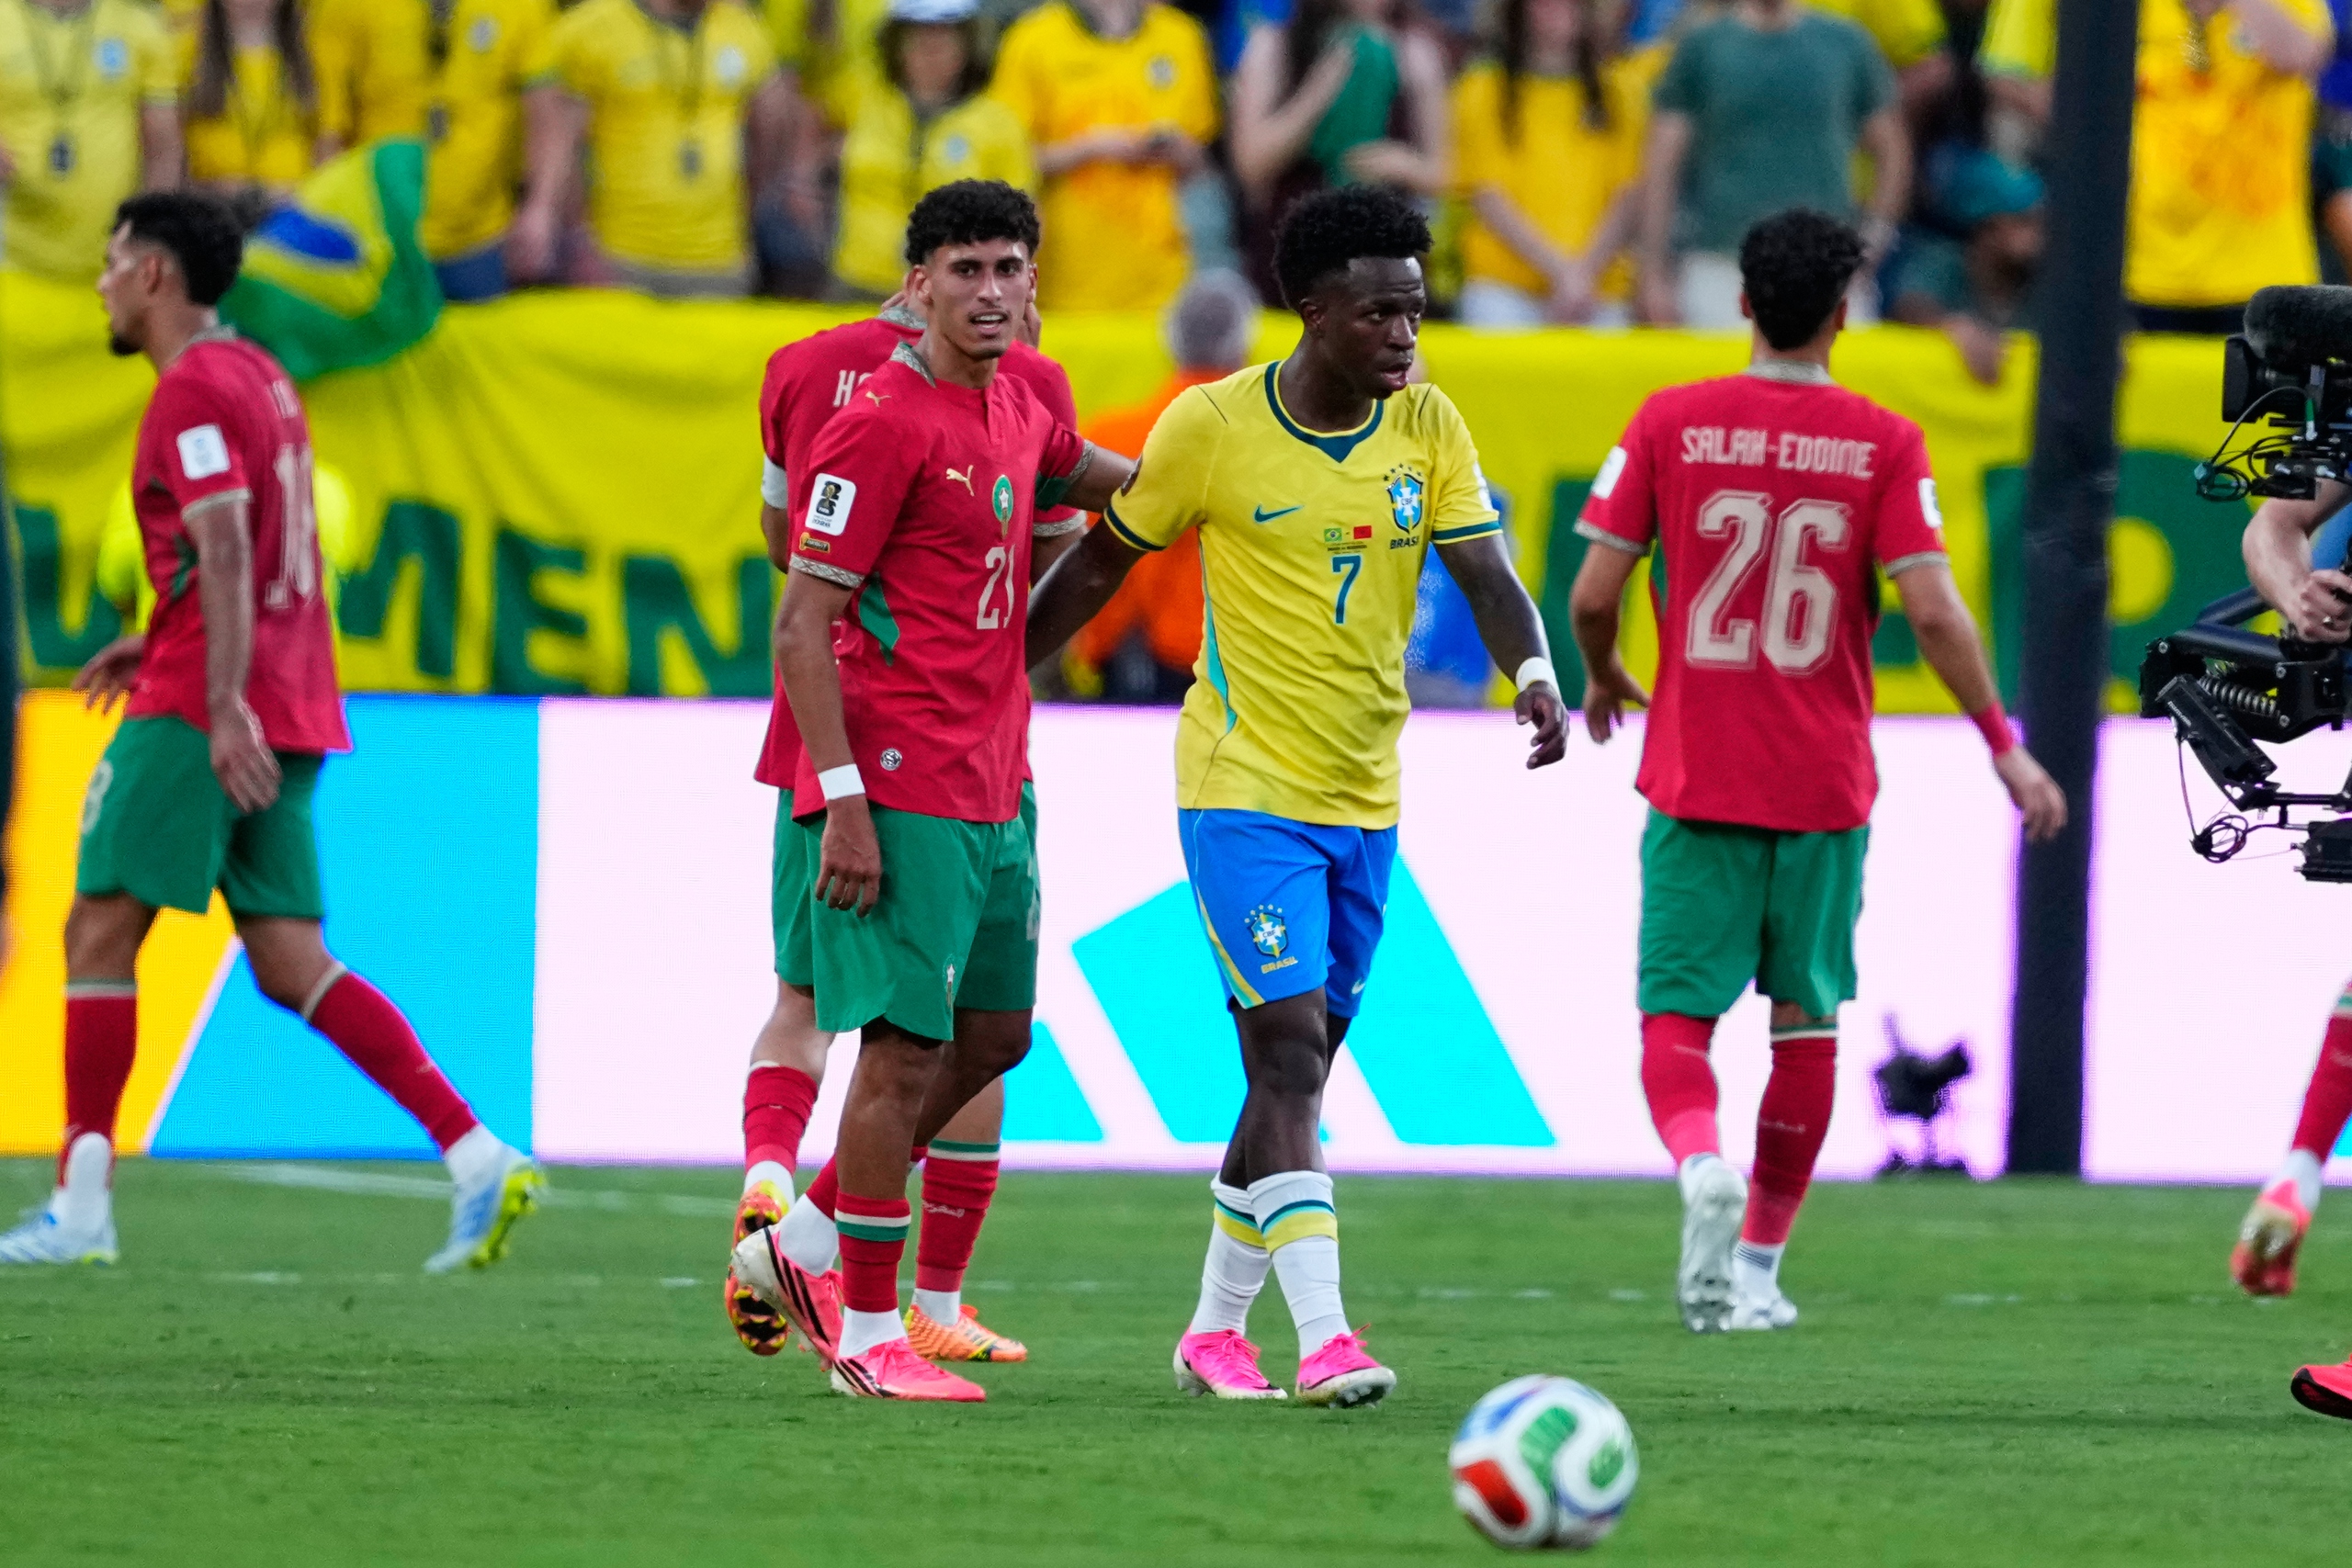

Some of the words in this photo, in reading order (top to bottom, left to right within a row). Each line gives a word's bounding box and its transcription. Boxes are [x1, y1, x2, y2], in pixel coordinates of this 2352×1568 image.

[977, 544, 1015, 630] 21
[1331, 554, 1362, 625] 7
[1685, 488, 1853, 676] 26
[1261, 929, 1276, 939] CBF
[1261, 955, 1298, 974] BRASIL
